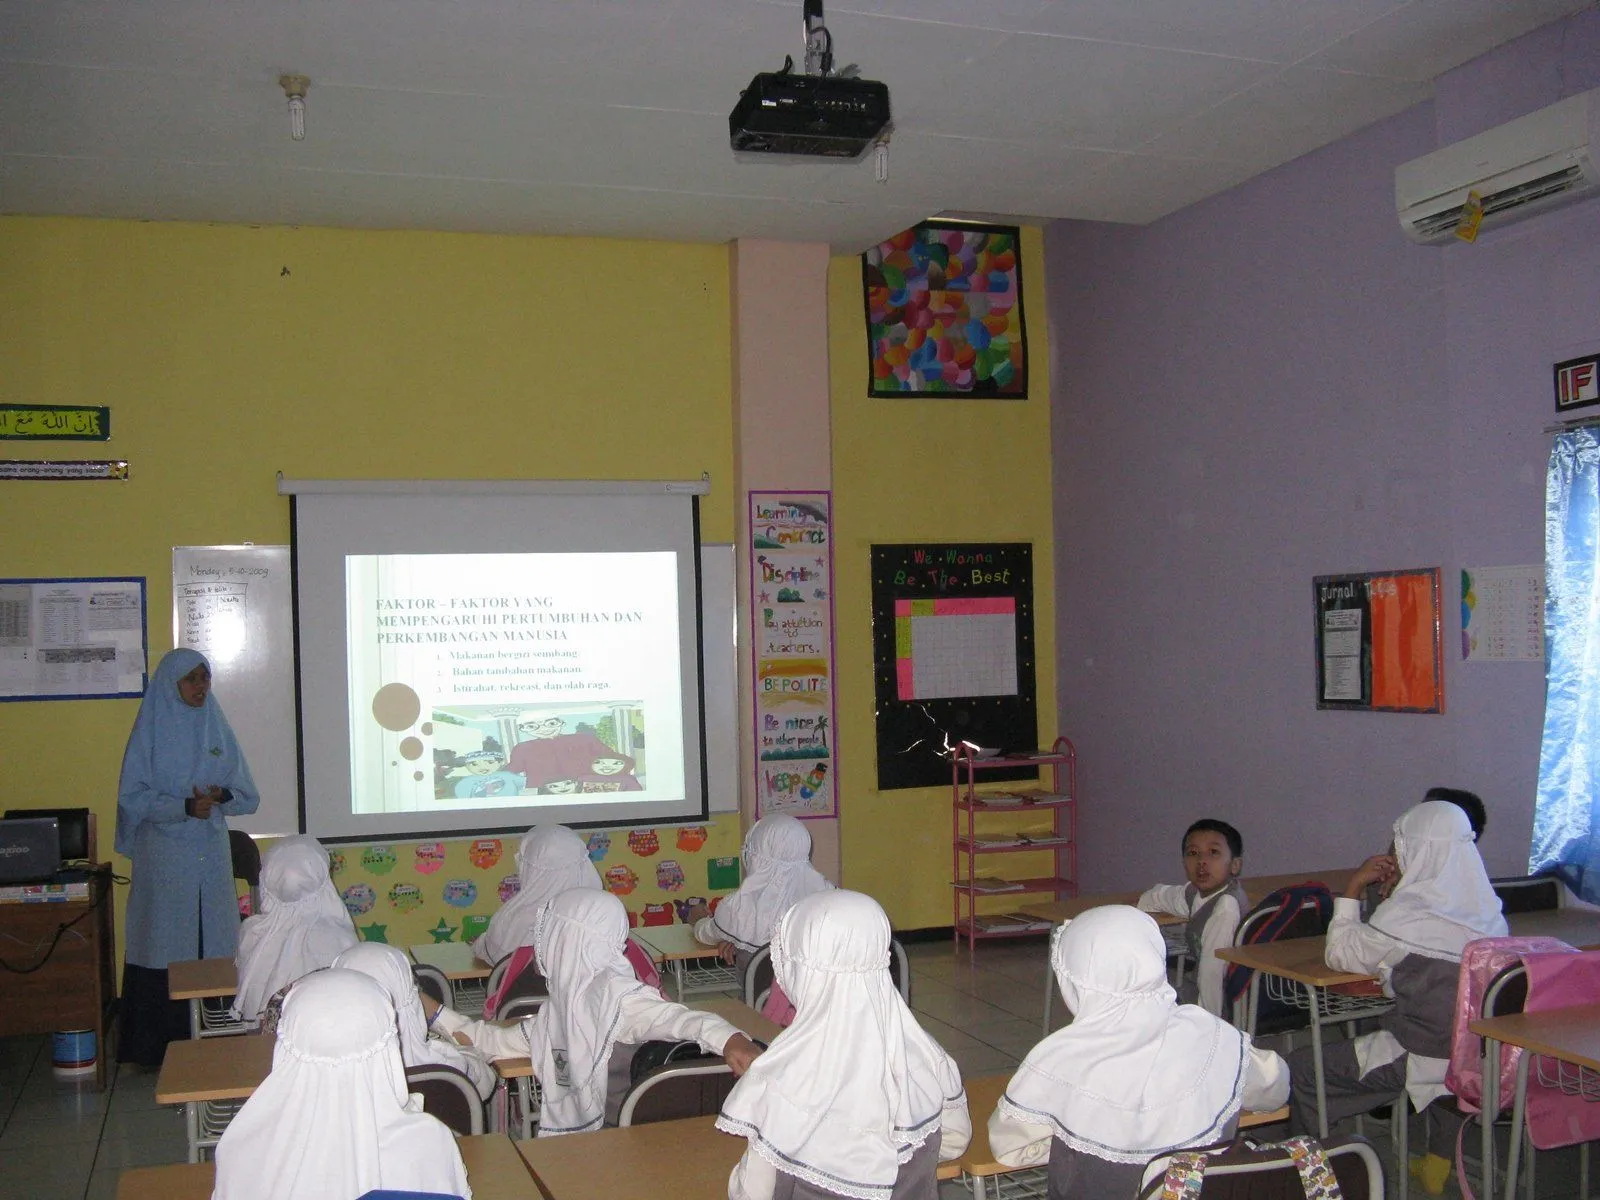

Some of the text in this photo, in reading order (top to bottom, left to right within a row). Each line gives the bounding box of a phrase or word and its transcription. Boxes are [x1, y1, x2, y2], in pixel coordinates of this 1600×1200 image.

[1561, 364, 1593, 402] IF
[67, 466, 83, 475] yang
[757, 505, 808, 523] Learning
[766, 526, 826, 544] Contract
[914, 549, 993, 564] We Wanna
[762, 562, 821, 585] Discipline
[894, 569, 1011, 588] Be The Best
[376, 599, 436, 610] FAKTOR
[451, 597, 509, 609] FAKTOR
[514, 596, 553, 608] YANG
[376, 611, 643, 627] MEMPENGARUHI PERTUMBUHAN DAN
[764, 608, 779, 631] Pay
[377, 630, 567, 644] PERKEMBANGAN MANUSIA
[450, 651, 495, 660] Makanan
[452, 667, 483, 676] Bahan
[486, 666, 534, 676] tambahan
[544, 681, 562, 691] dan
[564, 680, 585, 690] olah
[764, 678, 827, 692] BE POLITE
[765, 714, 813, 731] Be nice
[776, 733, 795, 745] other
